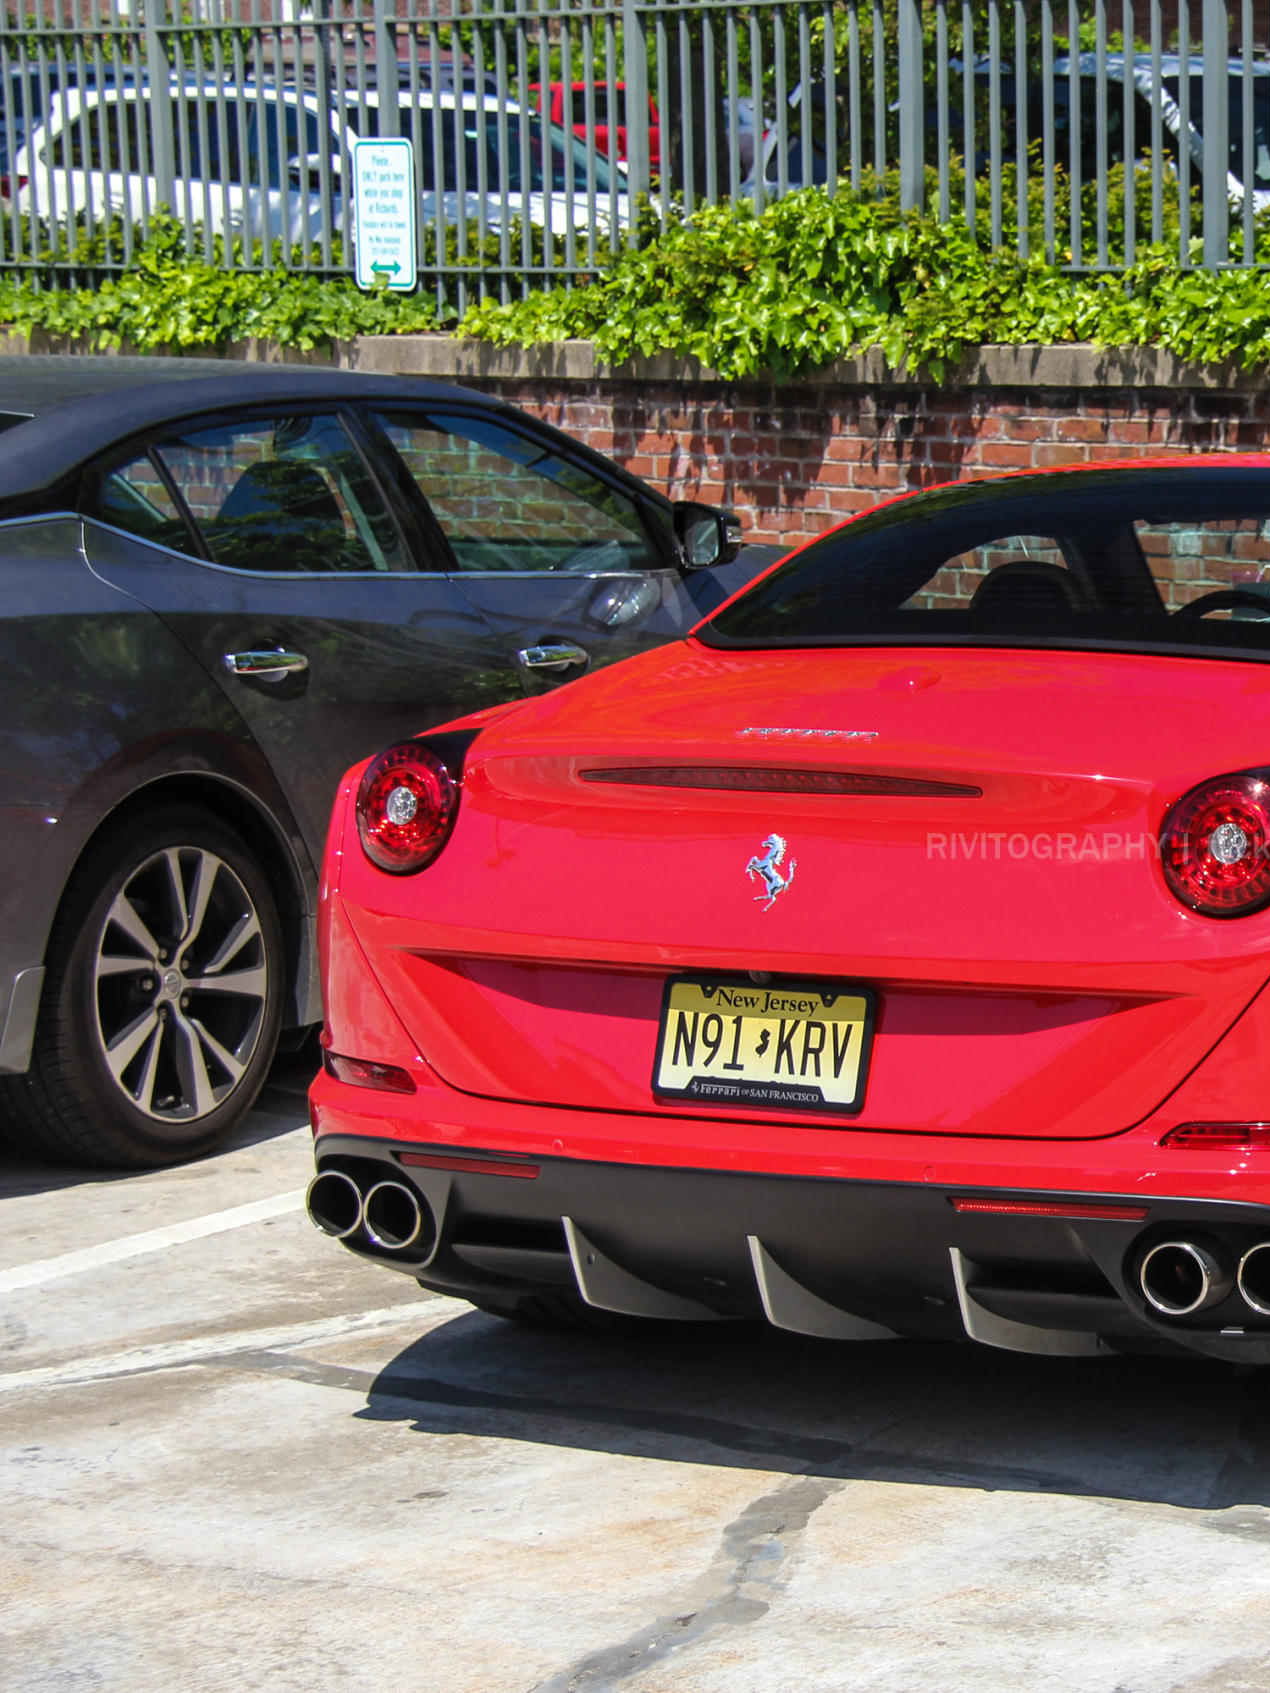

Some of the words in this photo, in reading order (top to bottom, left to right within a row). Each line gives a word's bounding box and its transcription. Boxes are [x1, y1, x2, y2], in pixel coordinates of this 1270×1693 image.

[716, 987, 760, 1009] New
[761, 991, 820, 1017] Jersey
[671, 1010, 745, 1072] N91
[773, 1018, 854, 1080] KRV
[700, 1083, 741, 1097] Ferrari
[750, 1087, 768, 1099] SAN
[768, 1090, 819, 1103] FRANCISCO
